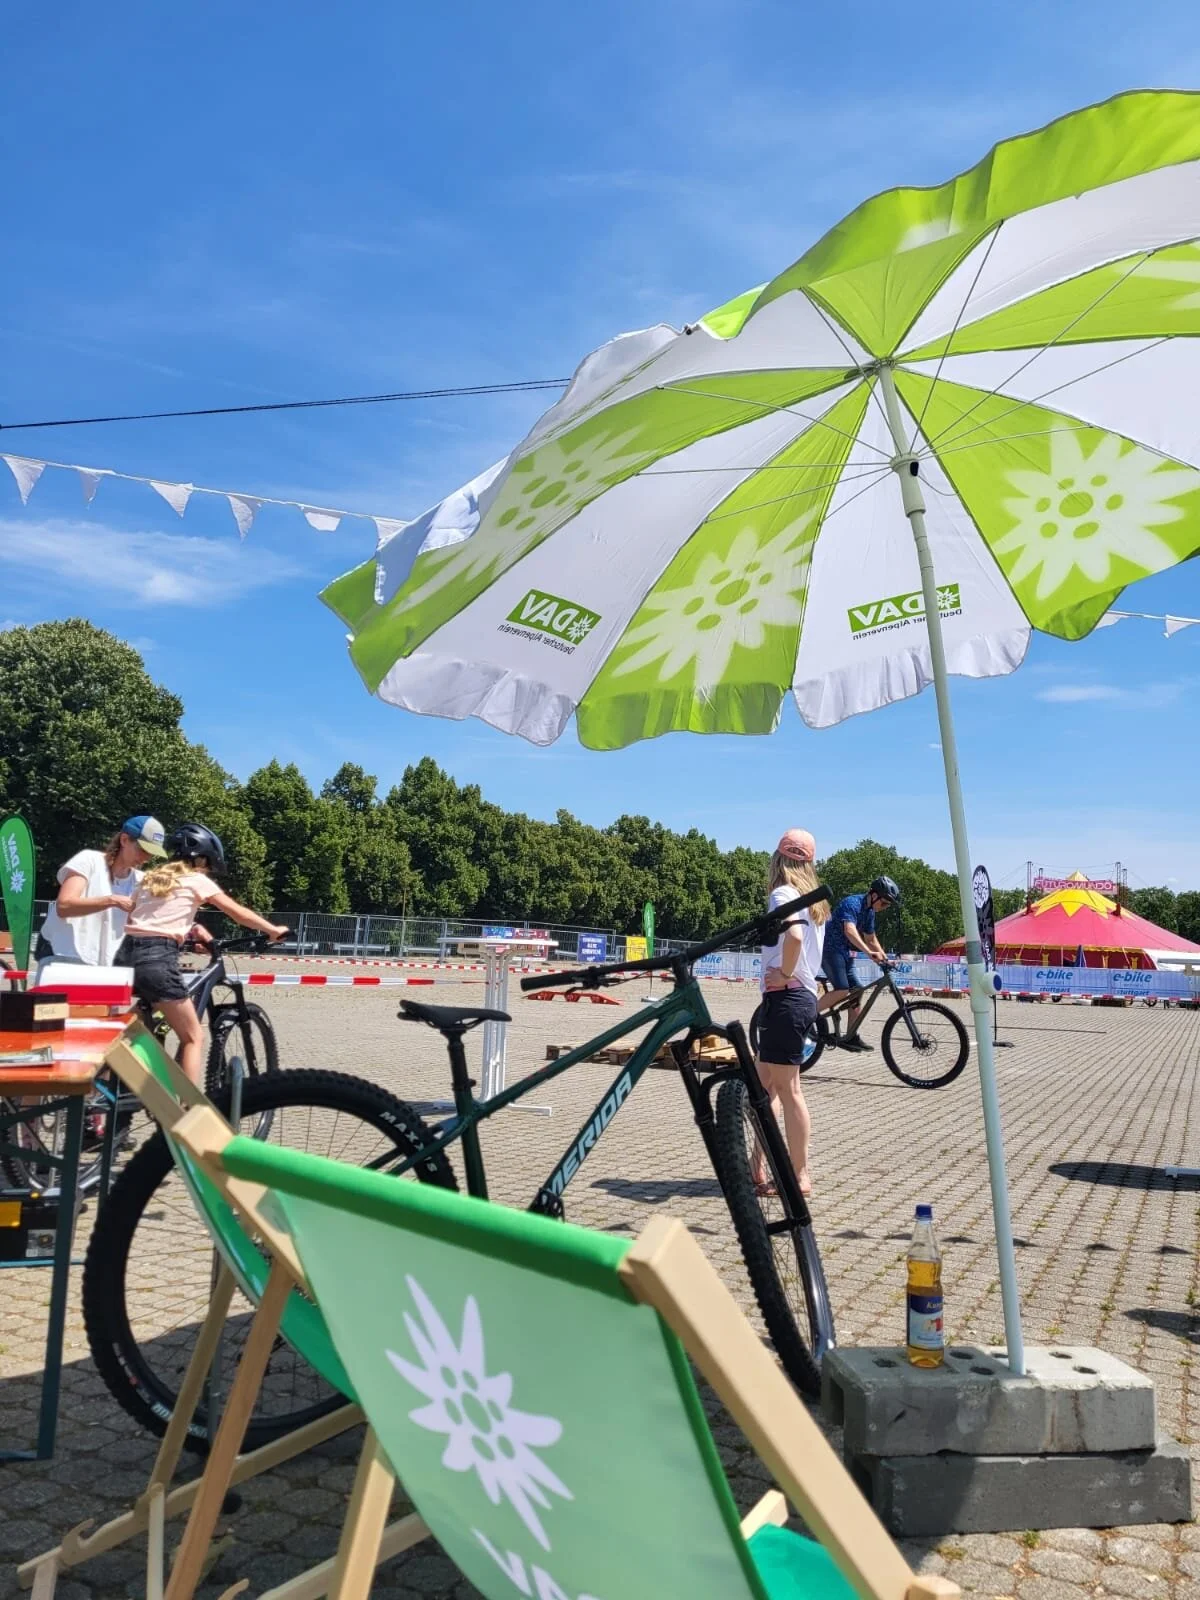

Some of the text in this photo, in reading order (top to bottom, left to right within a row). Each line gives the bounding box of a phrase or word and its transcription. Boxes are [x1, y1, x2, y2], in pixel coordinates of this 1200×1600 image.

[1034, 880, 1113, 890] FUTUROMUNDO
[1035, 969, 1074, 980] e-bike
[1112, 971, 1153, 983] e-bike
[547, 1071, 632, 1196] MERIDA
